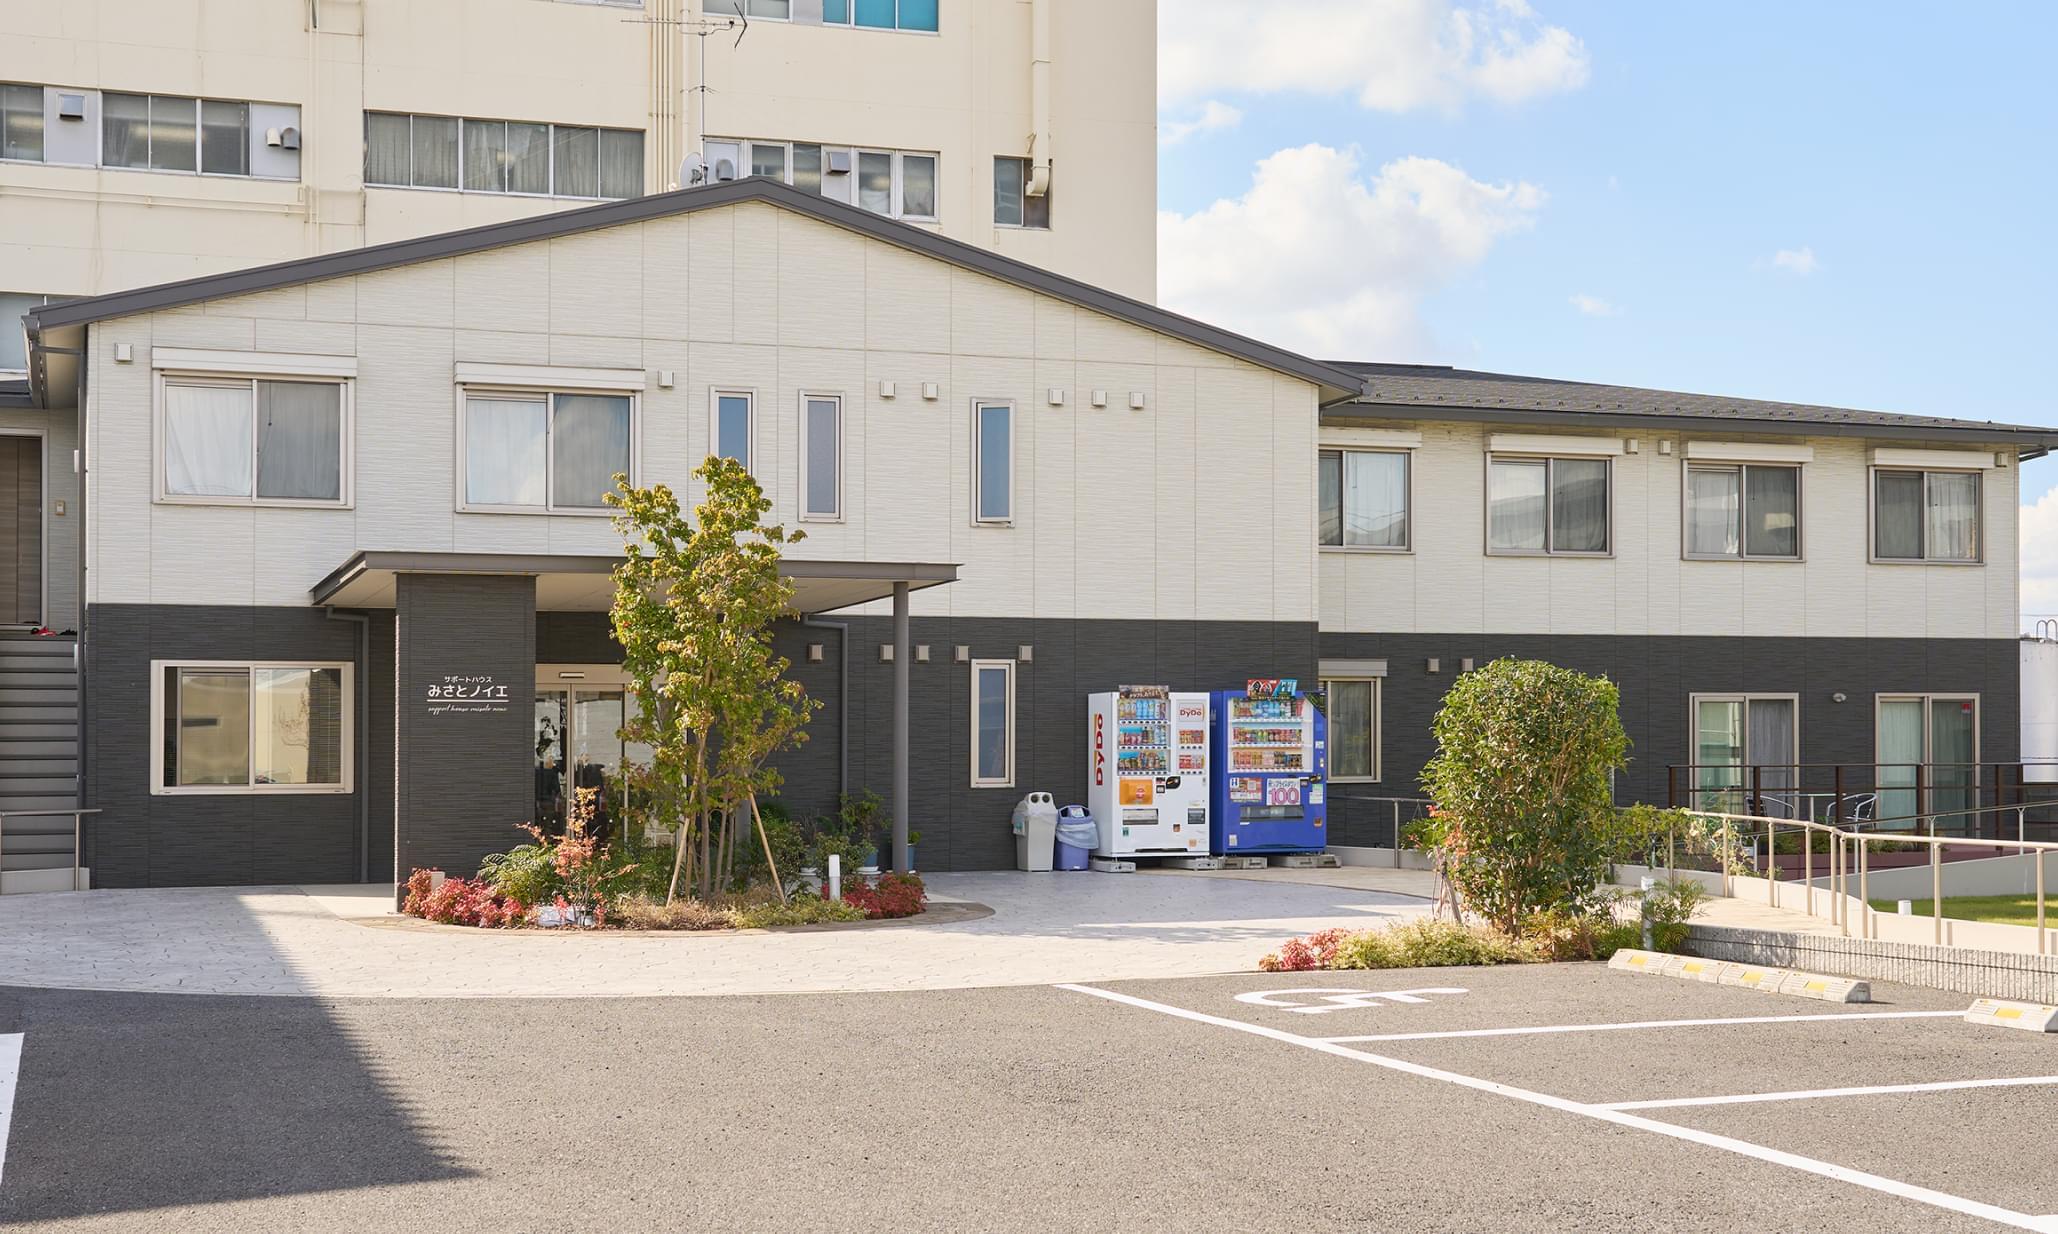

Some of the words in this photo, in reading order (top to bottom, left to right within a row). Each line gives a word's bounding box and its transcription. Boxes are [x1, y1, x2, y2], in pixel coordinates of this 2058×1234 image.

[427, 684, 508, 698] みさとノイエ
[1271, 787, 1299, 805] 100
